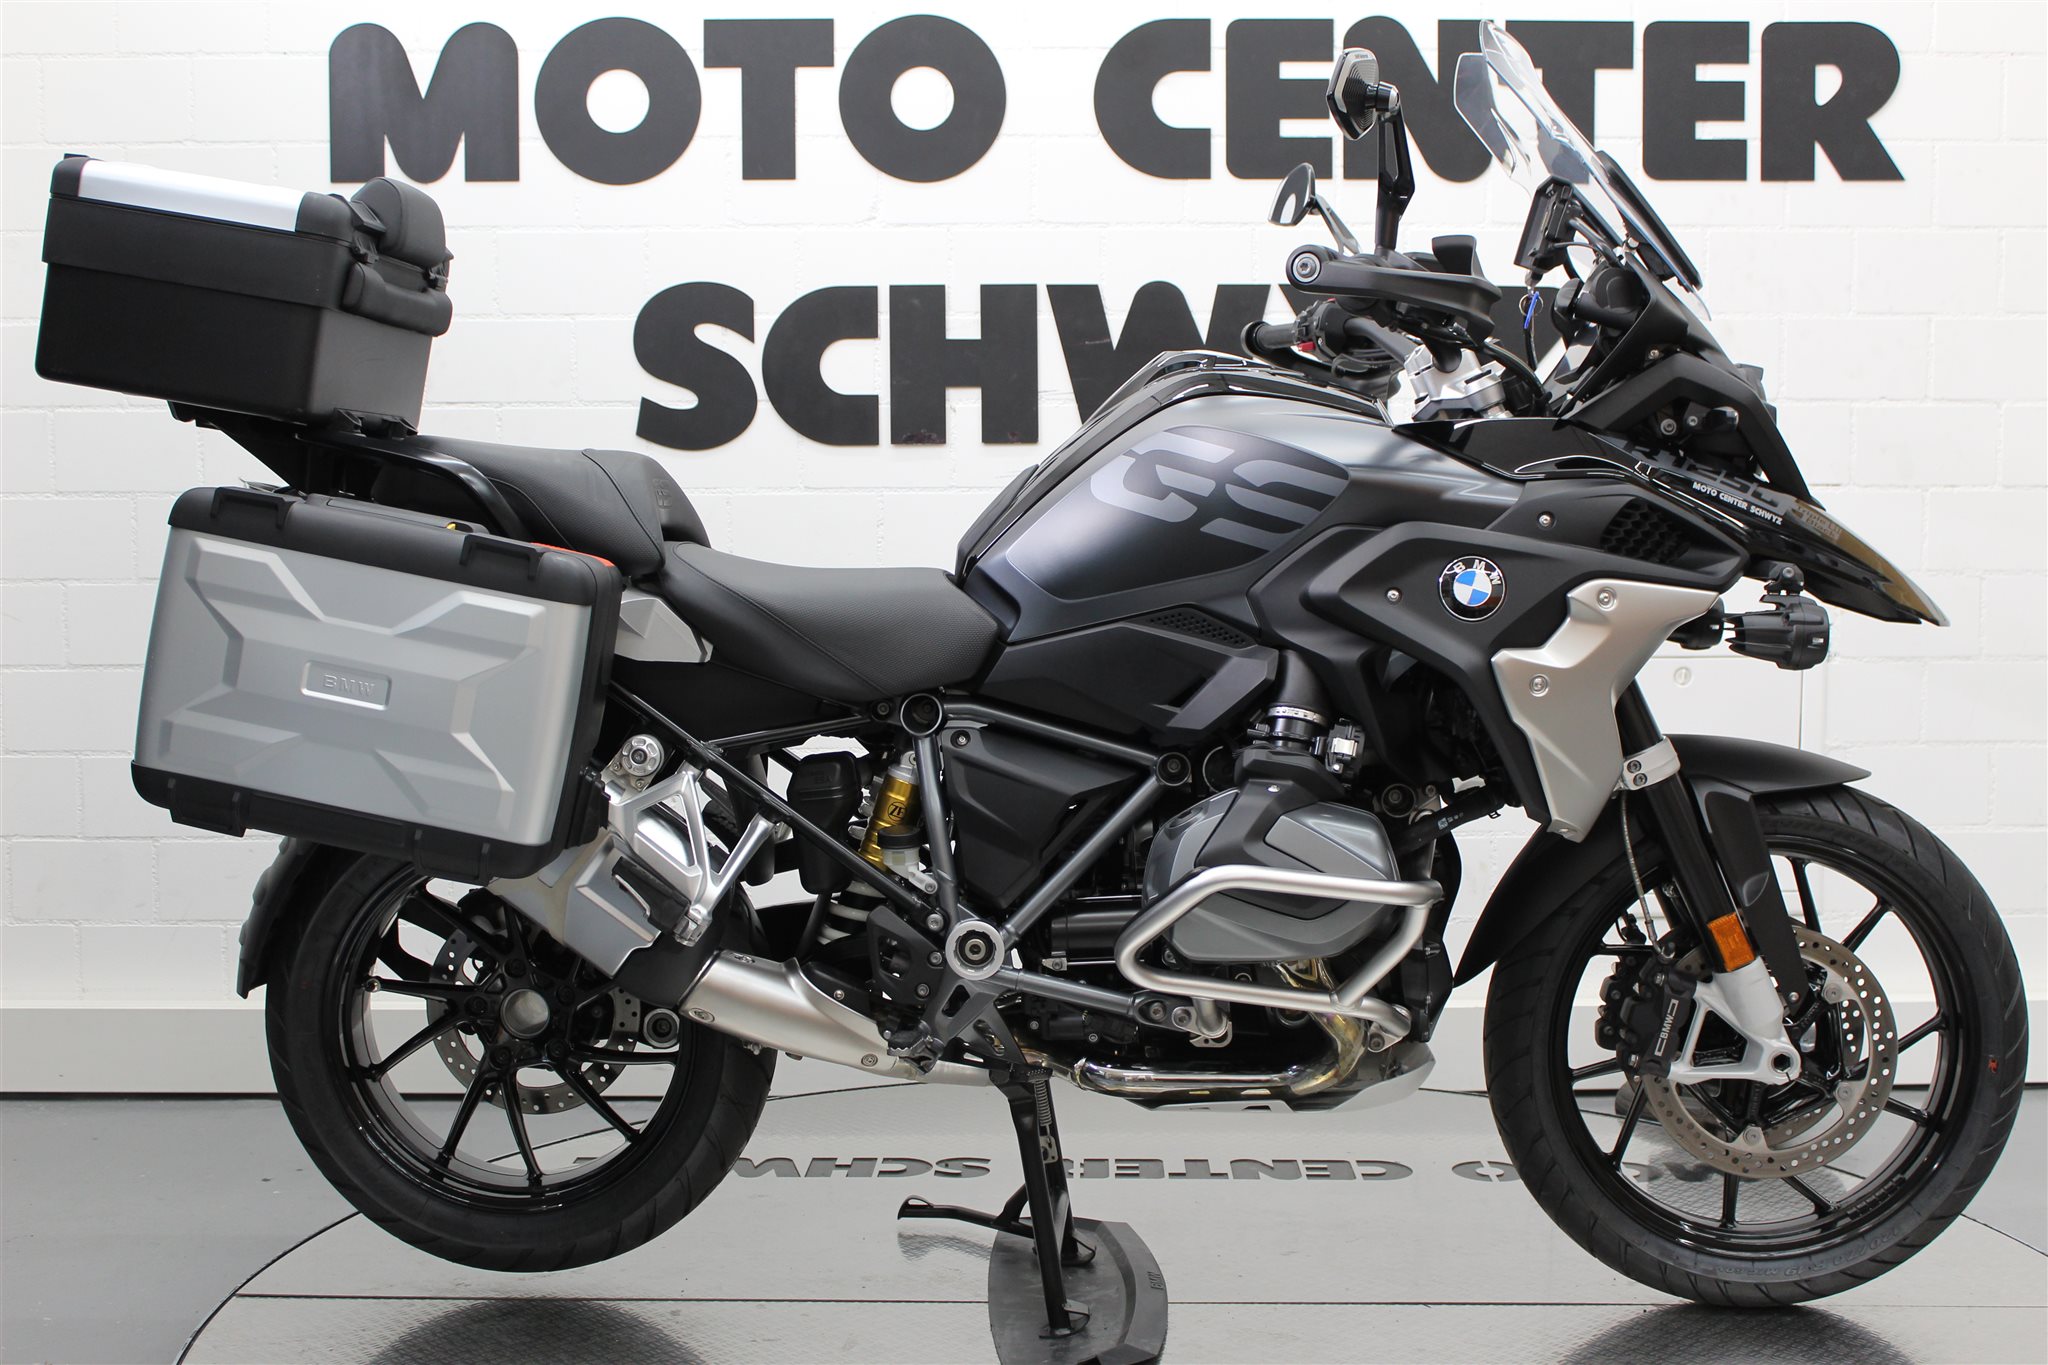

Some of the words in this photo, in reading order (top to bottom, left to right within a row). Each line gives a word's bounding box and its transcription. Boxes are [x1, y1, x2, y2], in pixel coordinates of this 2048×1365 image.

[329, 14, 1007, 186] MOTO
[1093, 15, 1905, 183] CENTER
[1090, 430, 1349, 552] GS
[1692, 481, 1718, 498] MOTO
[1719, 492, 1748, 511] CENTER
[1749, 505, 1783, 526] SCHWYZ
[1453, 559, 1502, 585] BMW
[323, 674, 375, 696] BMW
[889, 804, 906, 819] ZF
[1660, 1014, 1674, 1039] BMW
